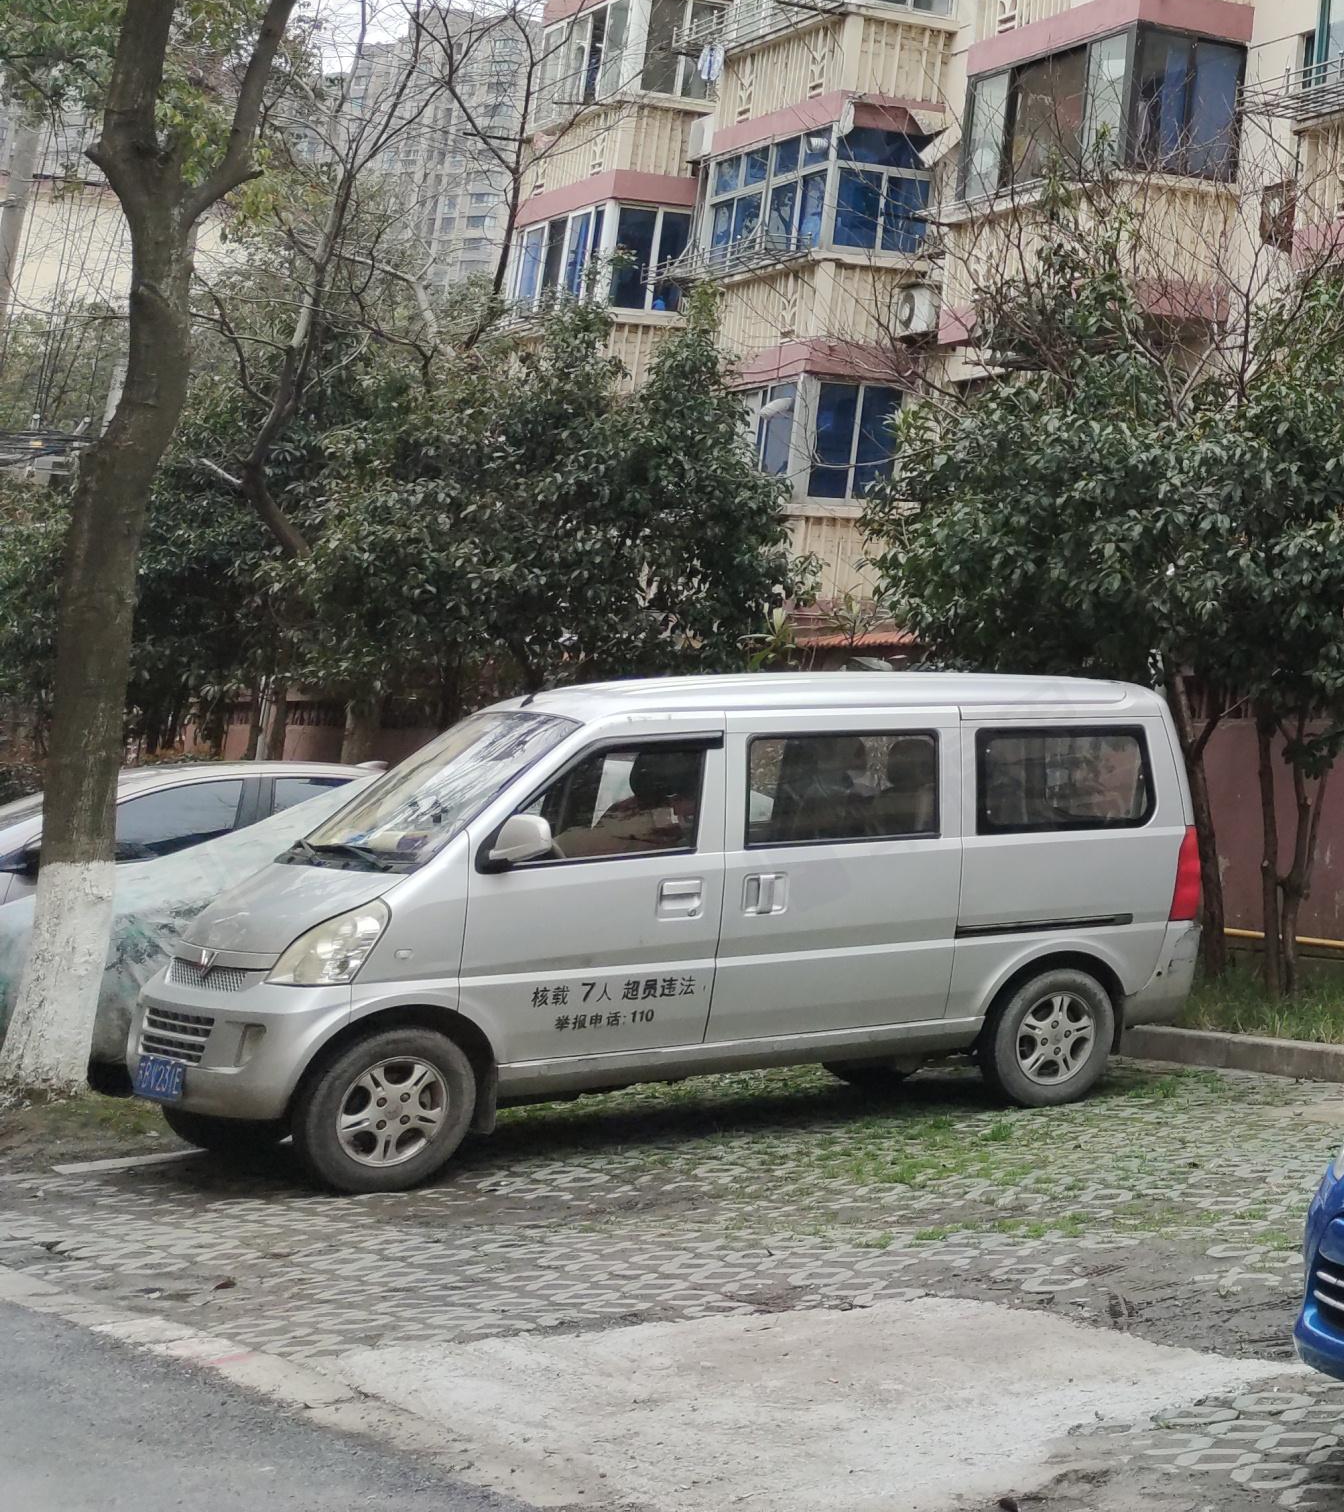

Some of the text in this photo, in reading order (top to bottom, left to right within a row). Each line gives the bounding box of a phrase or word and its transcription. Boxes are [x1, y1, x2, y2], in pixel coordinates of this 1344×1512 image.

[531, 986, 570, 1008] 核载
[621, 976, 697, 1001] 超员违法
